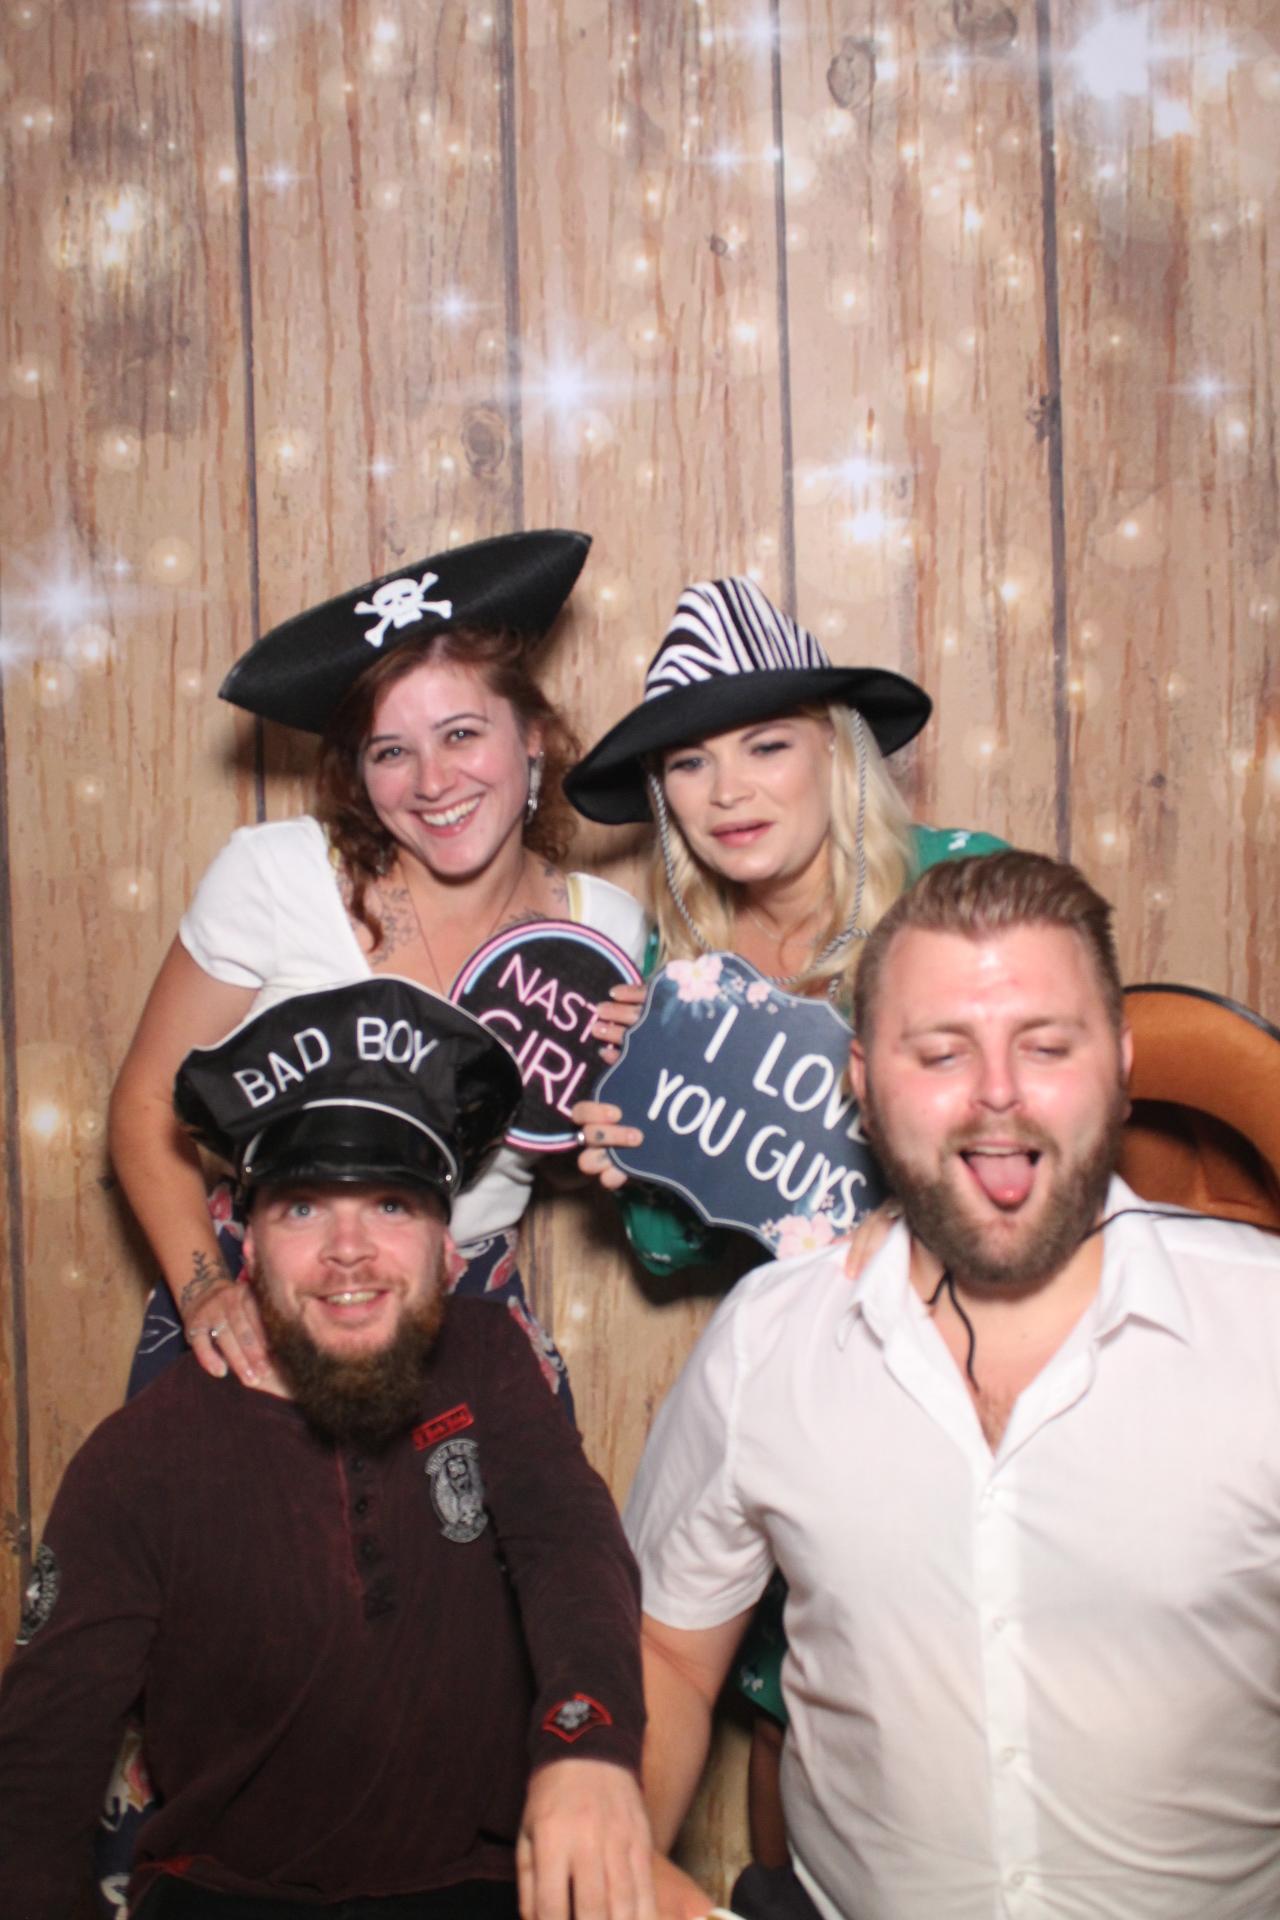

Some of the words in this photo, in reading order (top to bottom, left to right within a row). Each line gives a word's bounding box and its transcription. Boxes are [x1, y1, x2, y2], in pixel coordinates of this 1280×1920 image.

[497, 953, 600, 1044] NAST
[703, 1005, 740, 1063] I
[233, 1027, 331, 1108] BAD
[357, 1016, 439, 1074] BOY
[647, 1068, 747, 1158] YOU
[745, 1124, 867, 1229] GUYS
